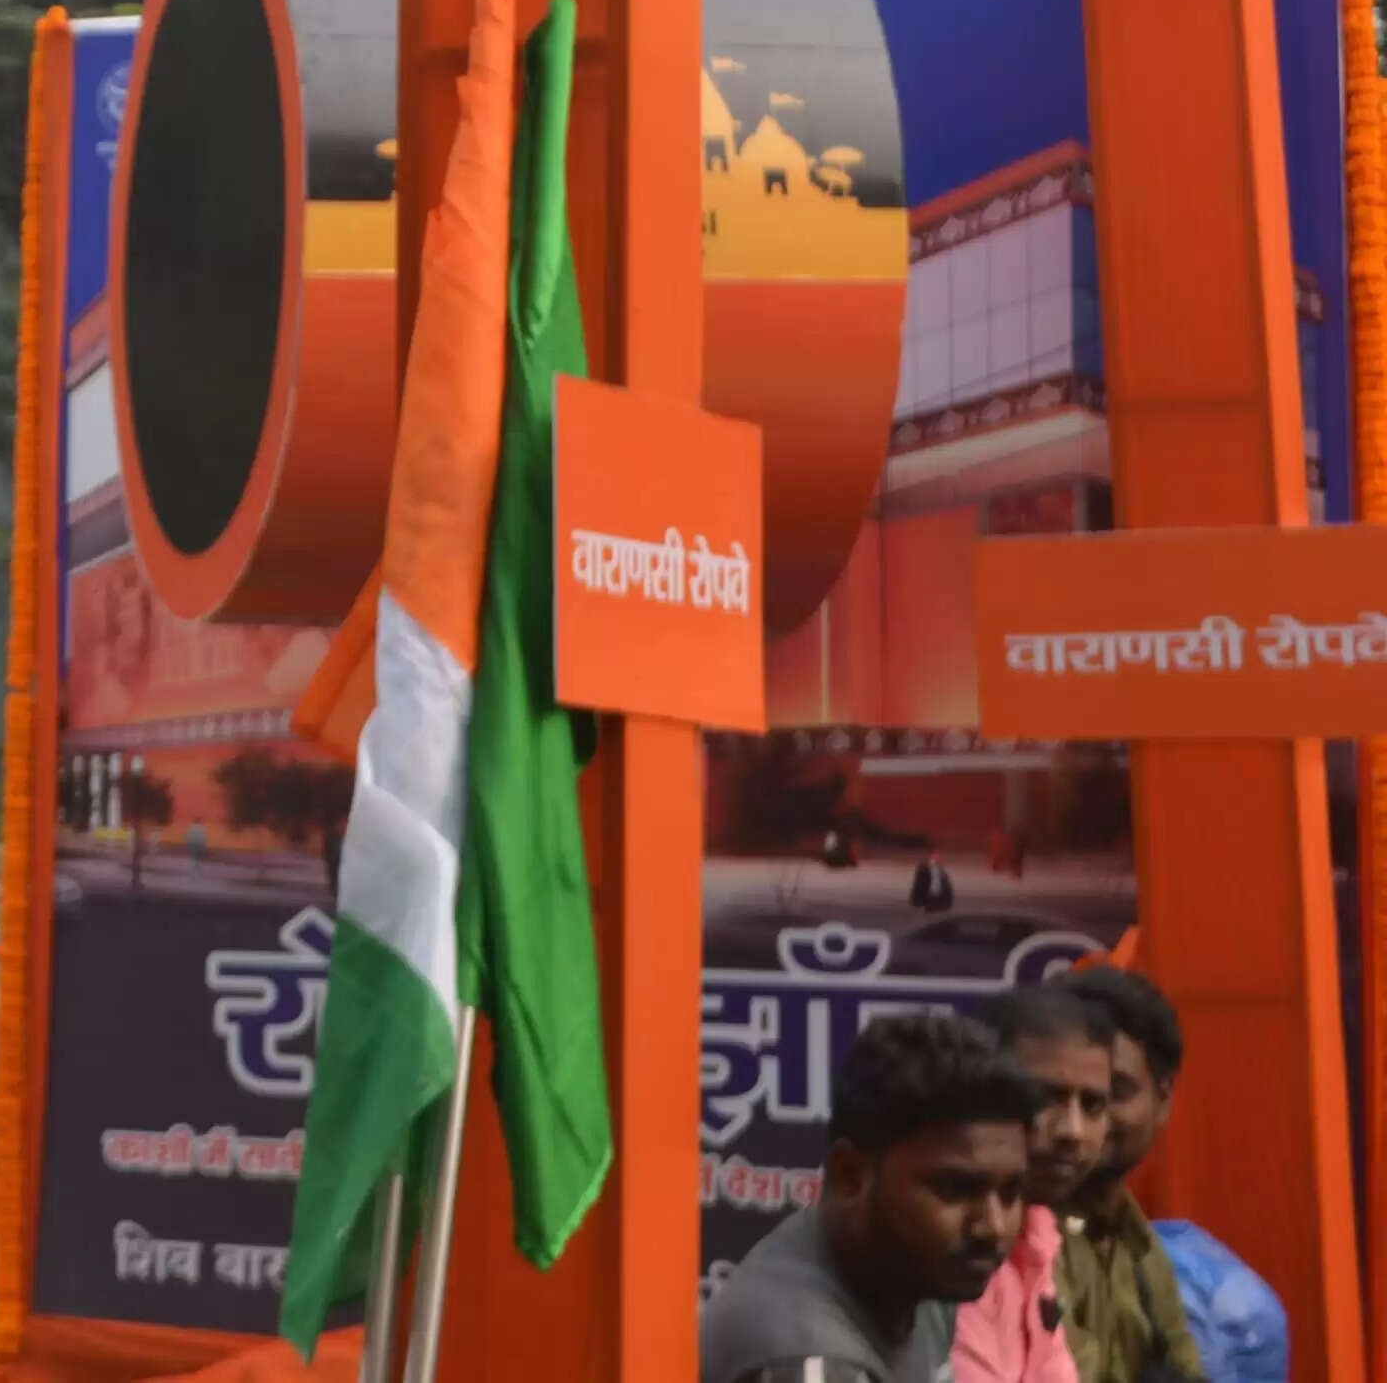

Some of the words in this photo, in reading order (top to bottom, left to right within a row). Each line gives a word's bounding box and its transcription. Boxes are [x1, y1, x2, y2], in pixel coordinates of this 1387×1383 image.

[570, 526, 686, 604] वाराणसी
[688, 533, 752, 618] रोपवे
[1003, 614, 1246, 675] वाराणसी
[112, 1218, 205, 1285] शिव
